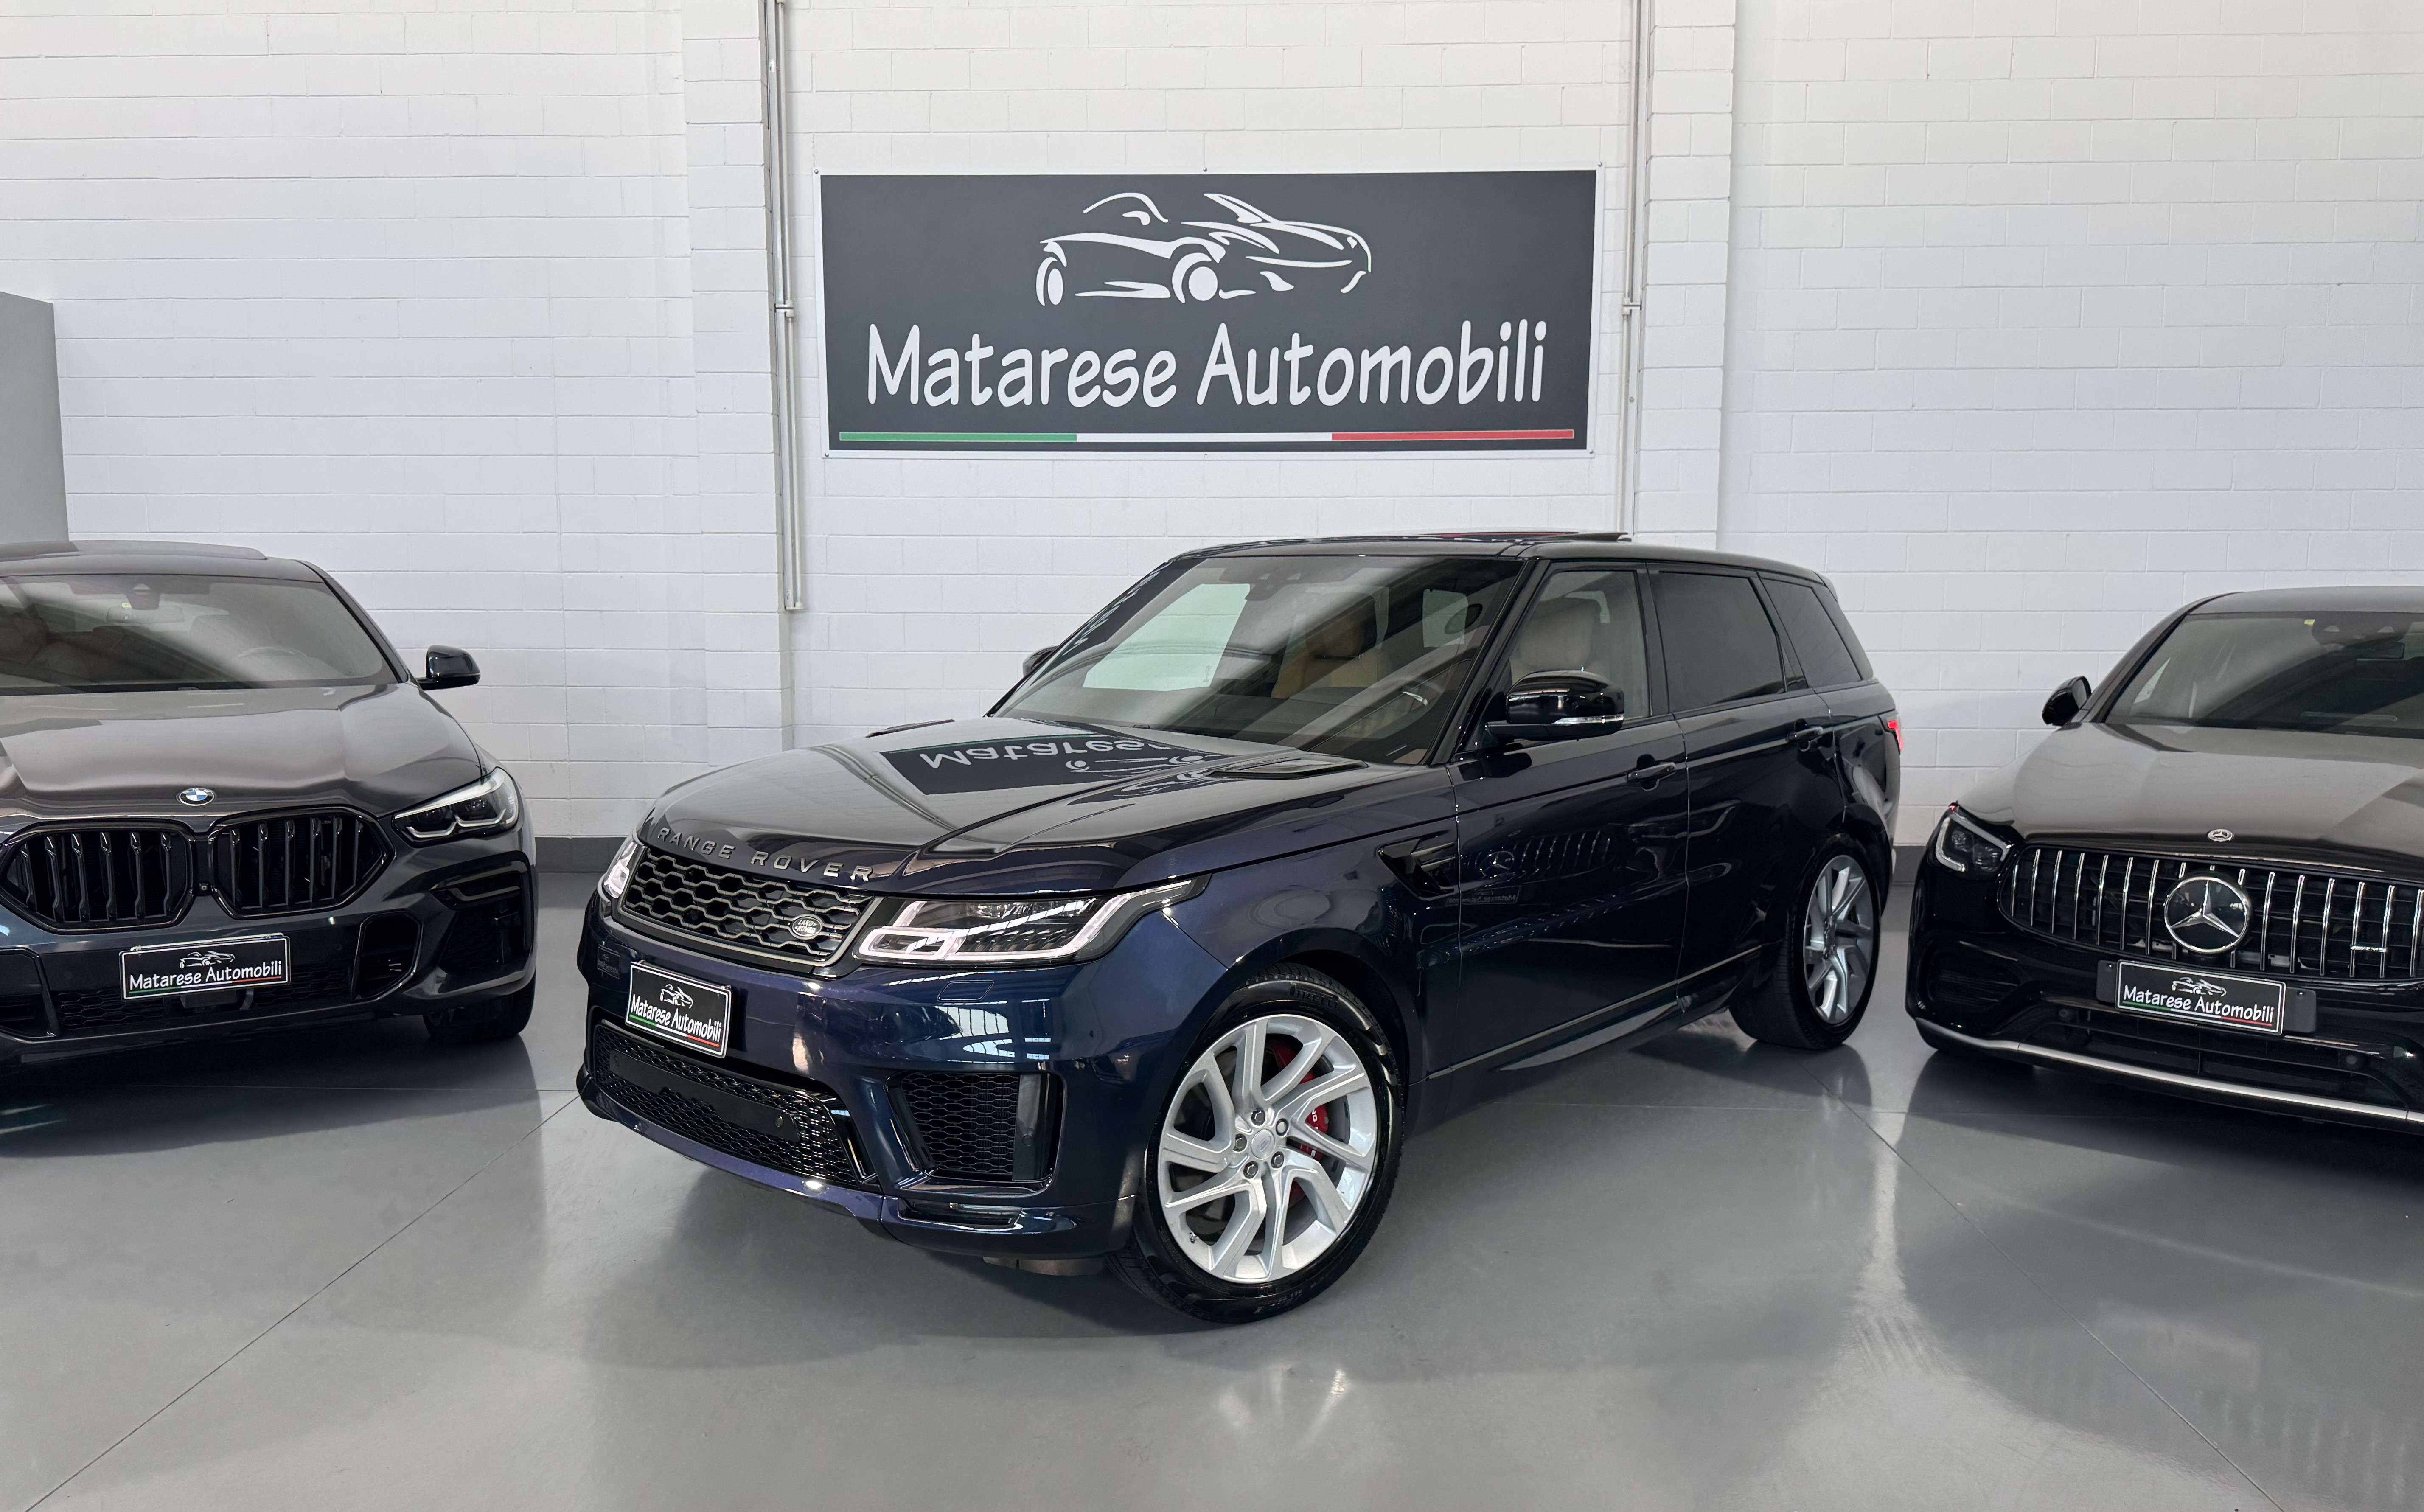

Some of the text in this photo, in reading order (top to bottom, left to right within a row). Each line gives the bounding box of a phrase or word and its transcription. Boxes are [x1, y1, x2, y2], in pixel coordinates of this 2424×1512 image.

[868, 319, 1547, 407] Matarese Automobili
[657, 827, 873, 881] RANGE ROVER
[129, 960, 282, 990] Matarese Automobili
[631, 994, 722, 1042] Matarese Automobili
[2123, 985, 2274, 1023] Matarese Automobili
